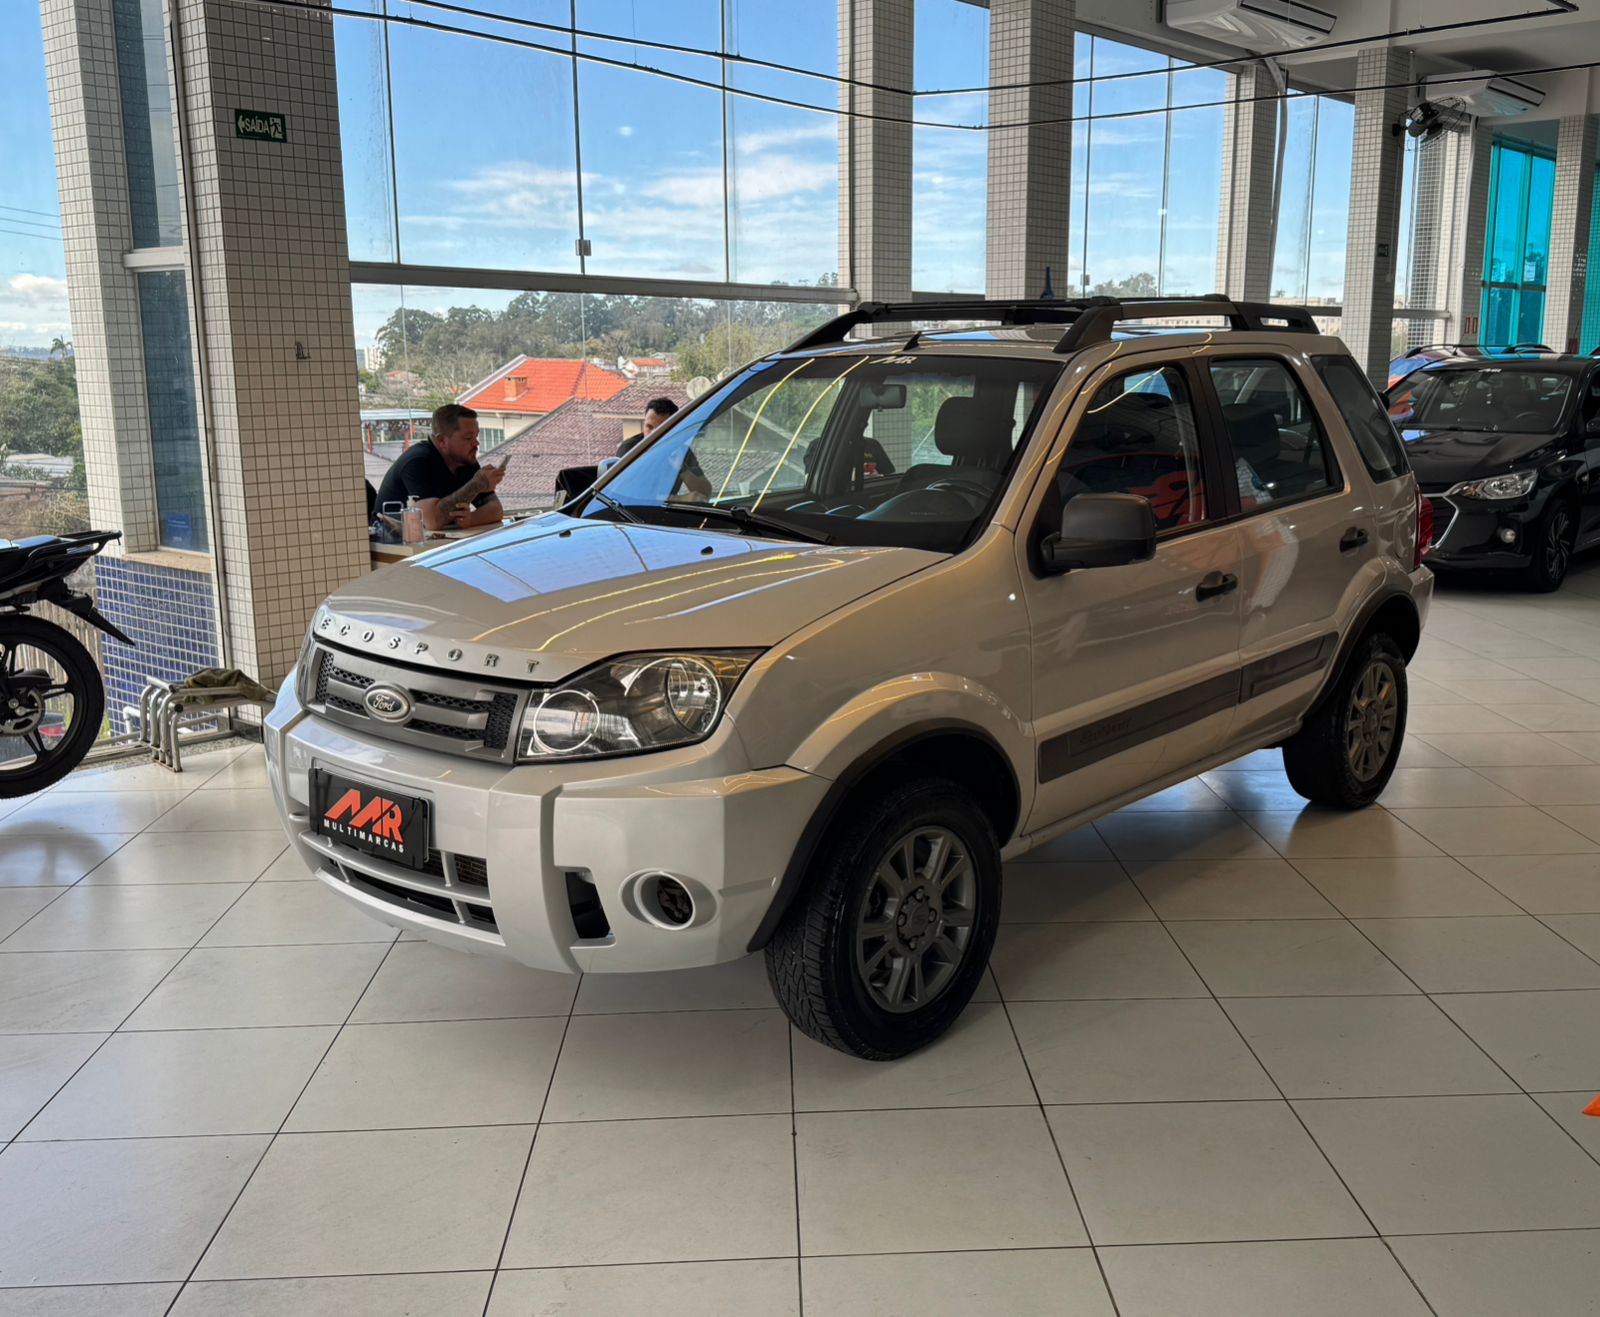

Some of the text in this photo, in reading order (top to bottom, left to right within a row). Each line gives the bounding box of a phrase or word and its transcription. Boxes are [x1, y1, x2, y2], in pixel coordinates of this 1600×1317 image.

[244, 115, 270, 134] SAÍDA
[320, 617, 540, 674] ECOSPORT
[372, 692, 396, 712] Ford
[323, 818, 405, 853] MULTIMARCAS
